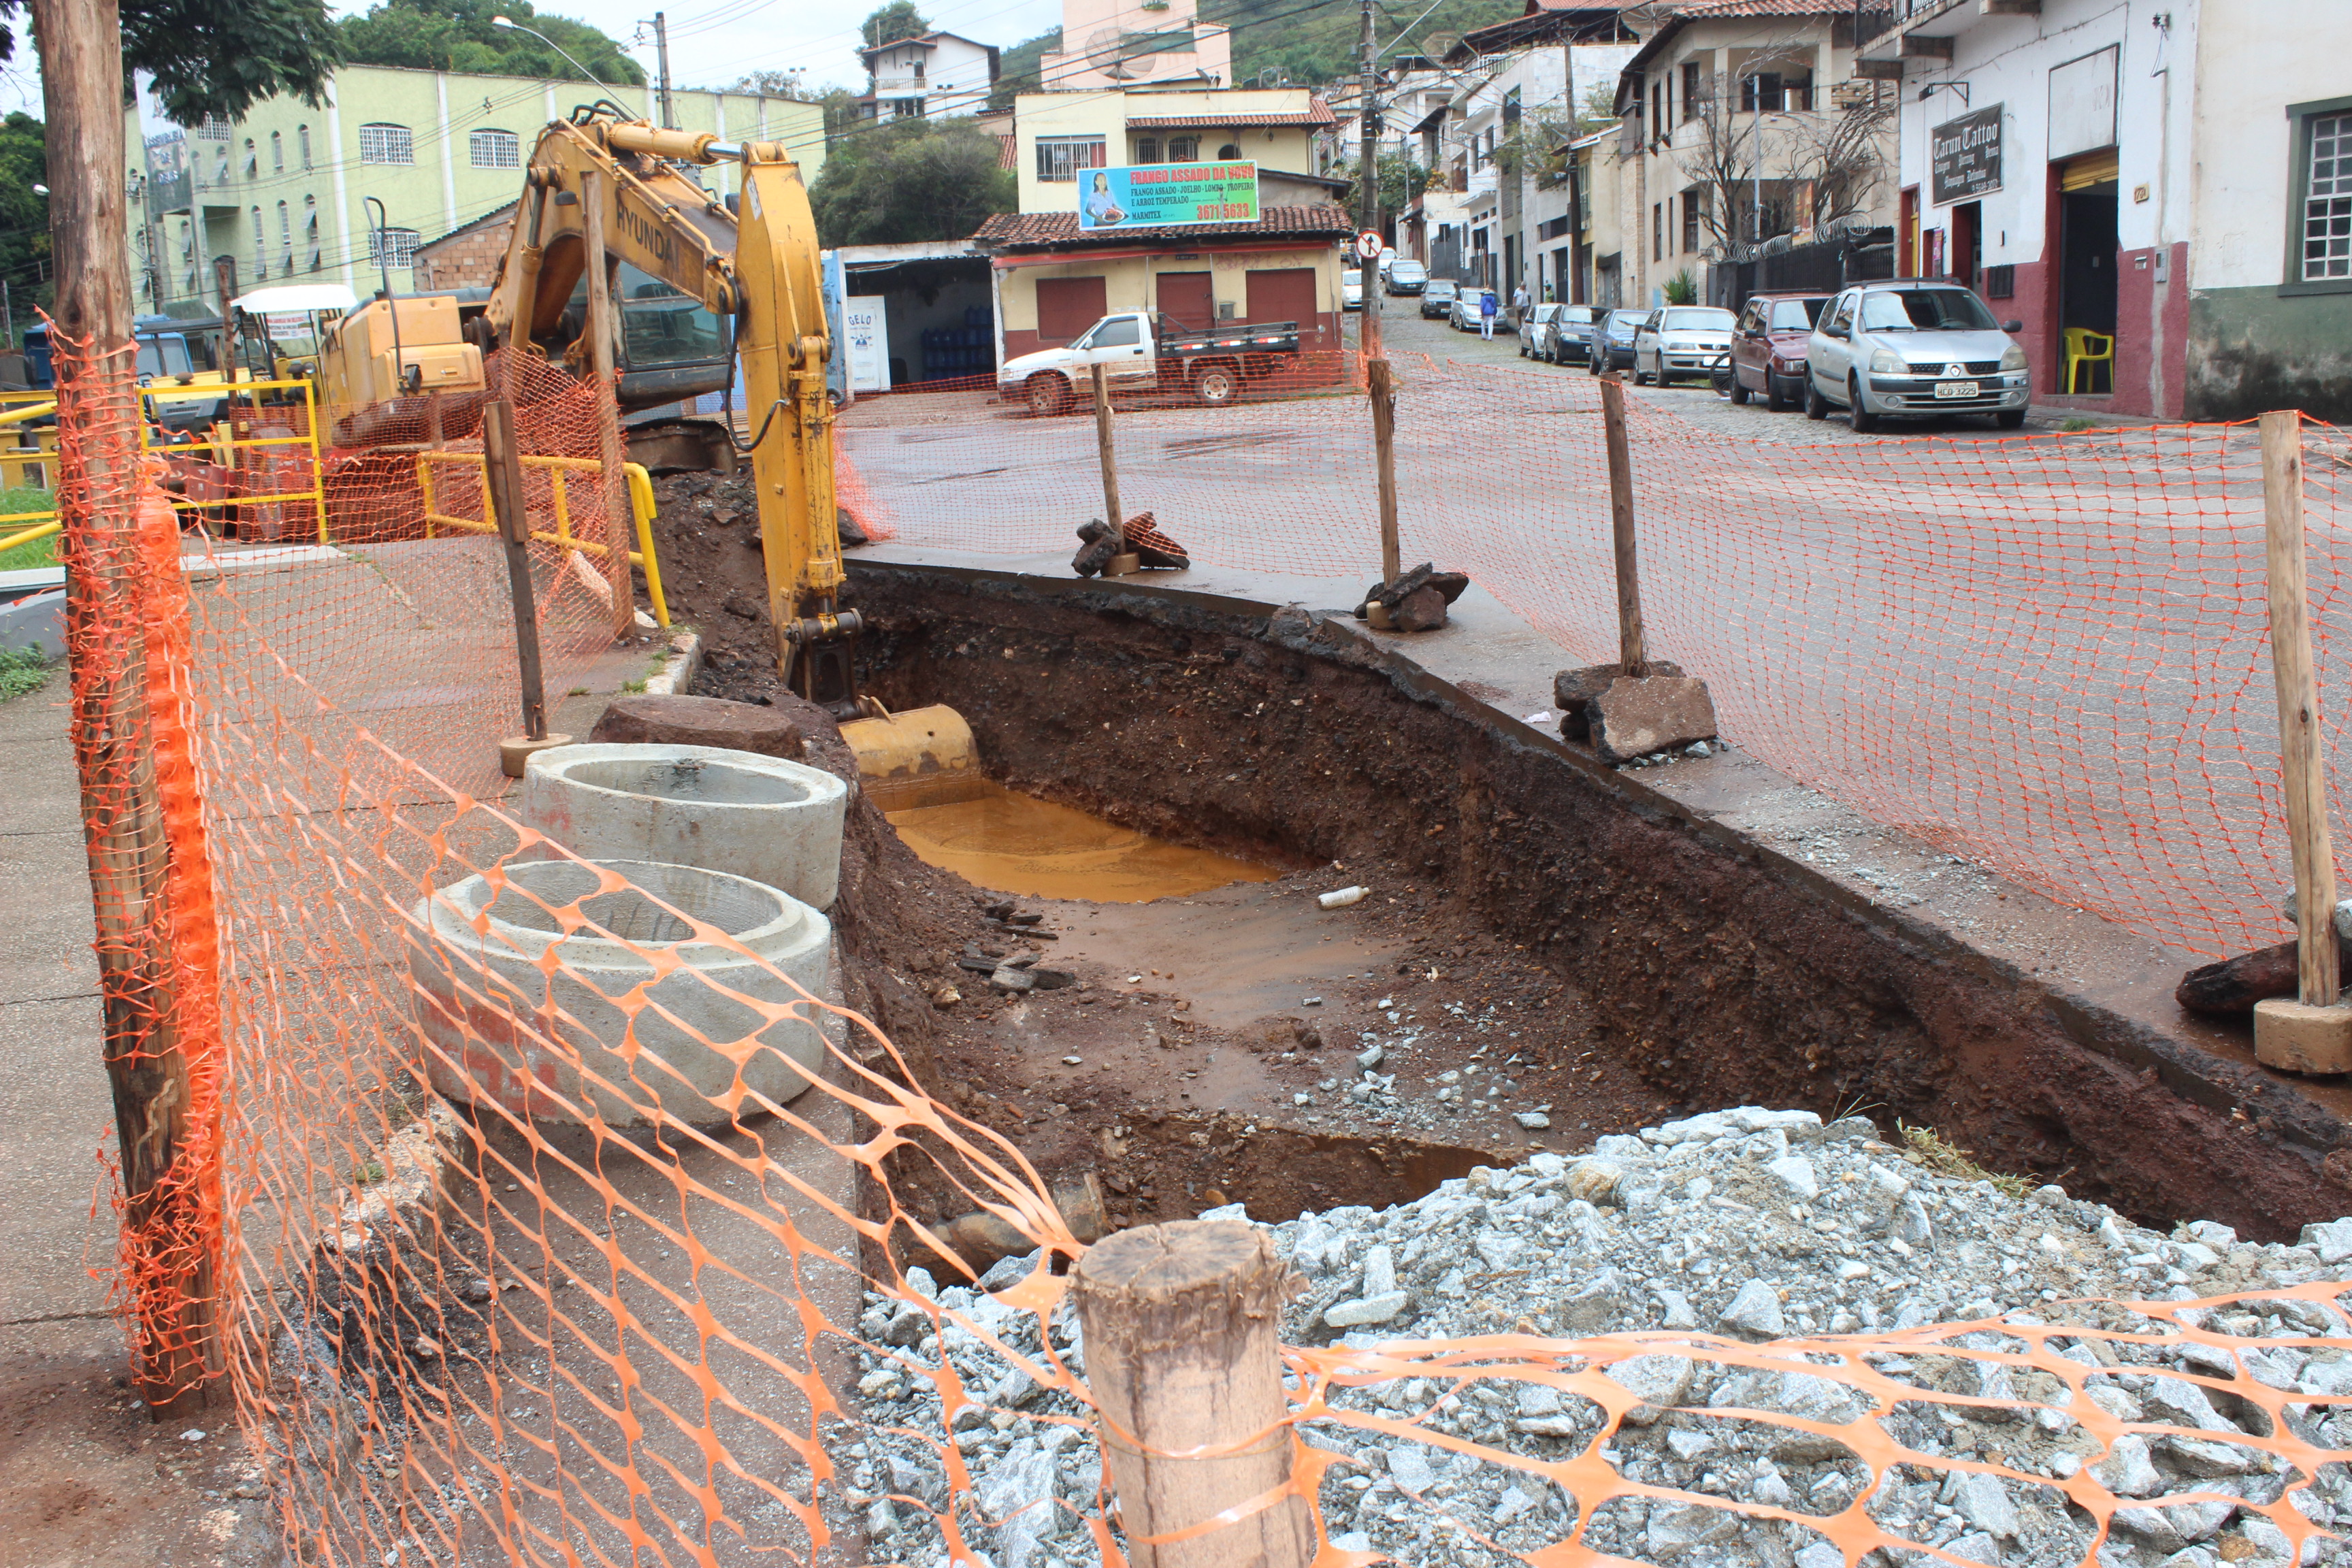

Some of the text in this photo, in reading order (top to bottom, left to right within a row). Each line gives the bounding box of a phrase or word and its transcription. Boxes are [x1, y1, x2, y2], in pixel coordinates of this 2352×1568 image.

[1933, 123, 1999, 160] Tarun Tattoo
[1130, 163, 1255, 184] FRANGO ASSADO DA VOVÓ
[1130, 182, 1254, 197] FRANGO ASSADO JOELHO LOMBO TROPEIRO
[1131, 199, 1135, 207] E
[1136, 197, 1155, 206] ARROZ
[1156, 195, 1189, 206] TEMPERADO
[1132, 210, 1162, 220] MARMITEX
[1196, 203, 1250, 220] 3671 5633
[848, 314, 872, 325] GELO
